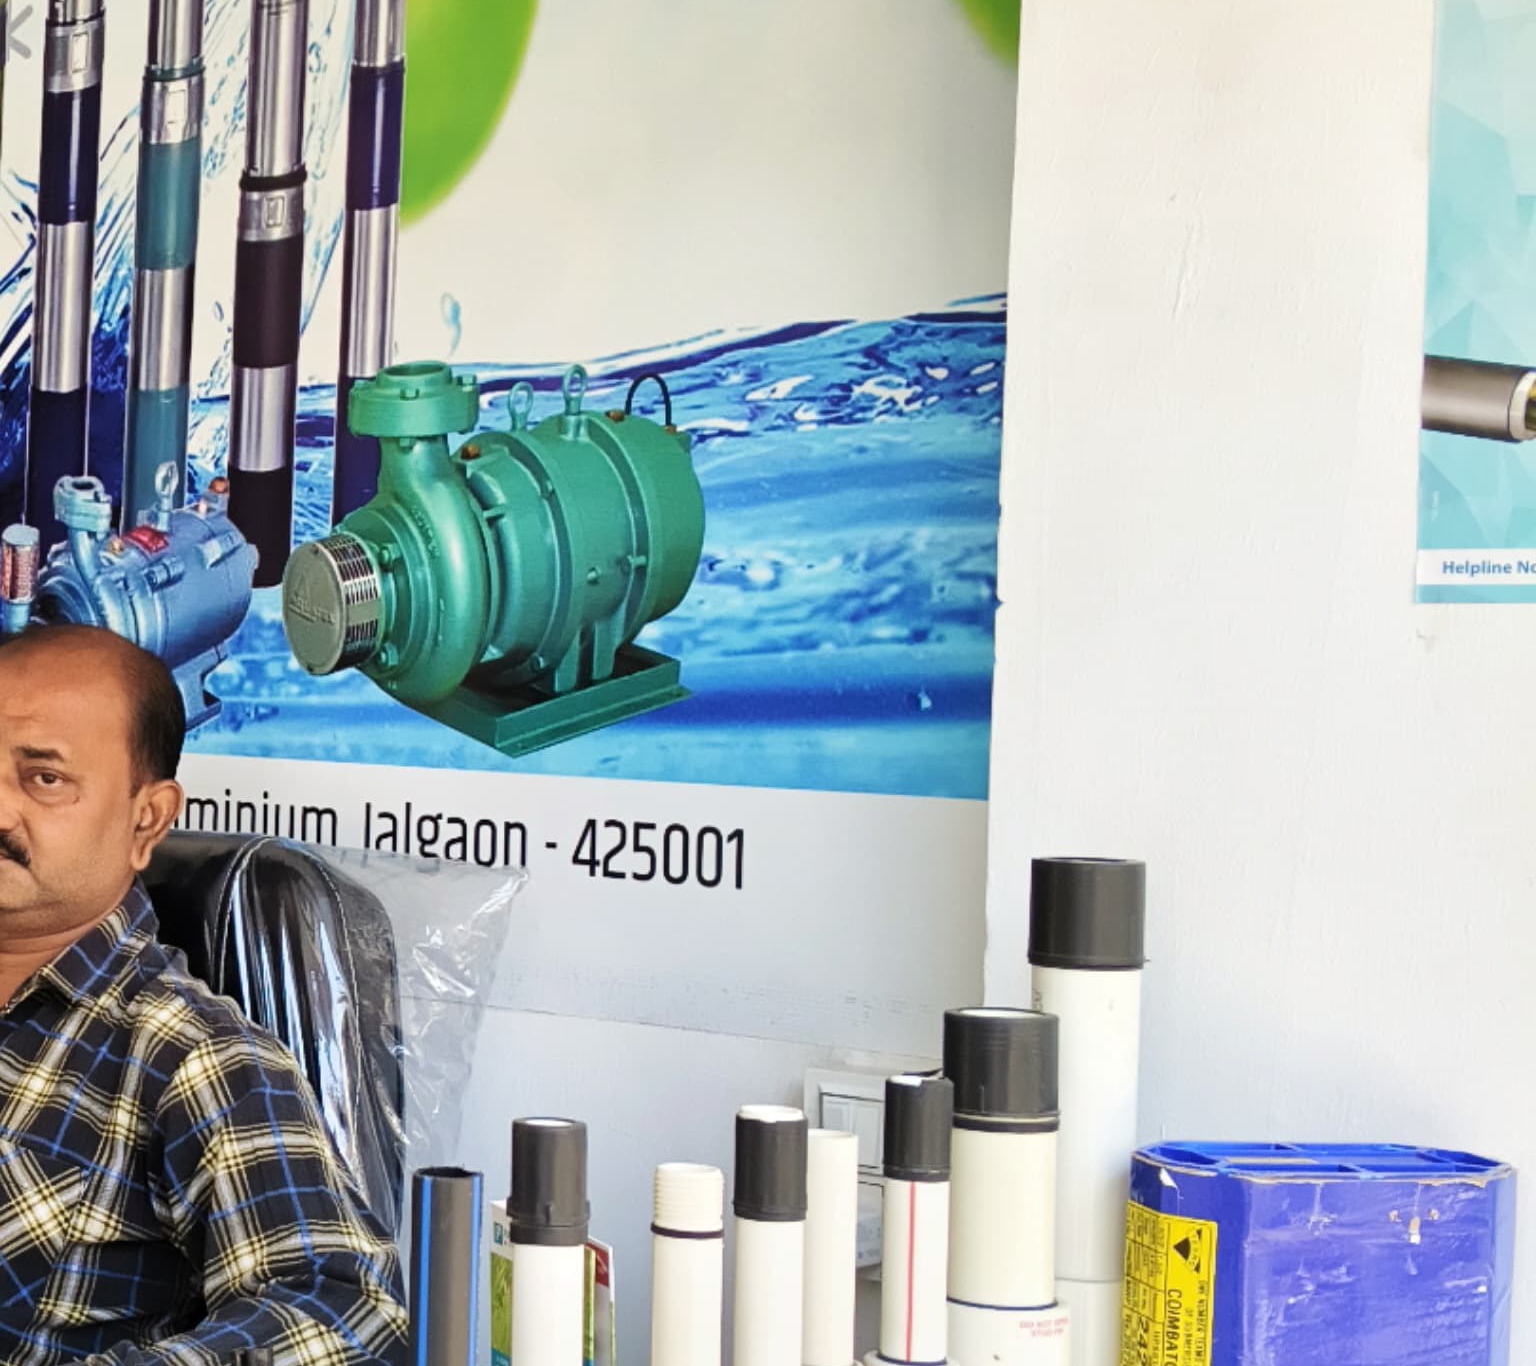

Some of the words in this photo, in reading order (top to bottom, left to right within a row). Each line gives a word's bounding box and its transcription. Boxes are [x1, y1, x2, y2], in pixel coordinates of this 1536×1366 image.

[1442, 559, 1513, 578] Helpline
[175, 788, 338, 847] minium
[571, 818, 745, 889] 425001
